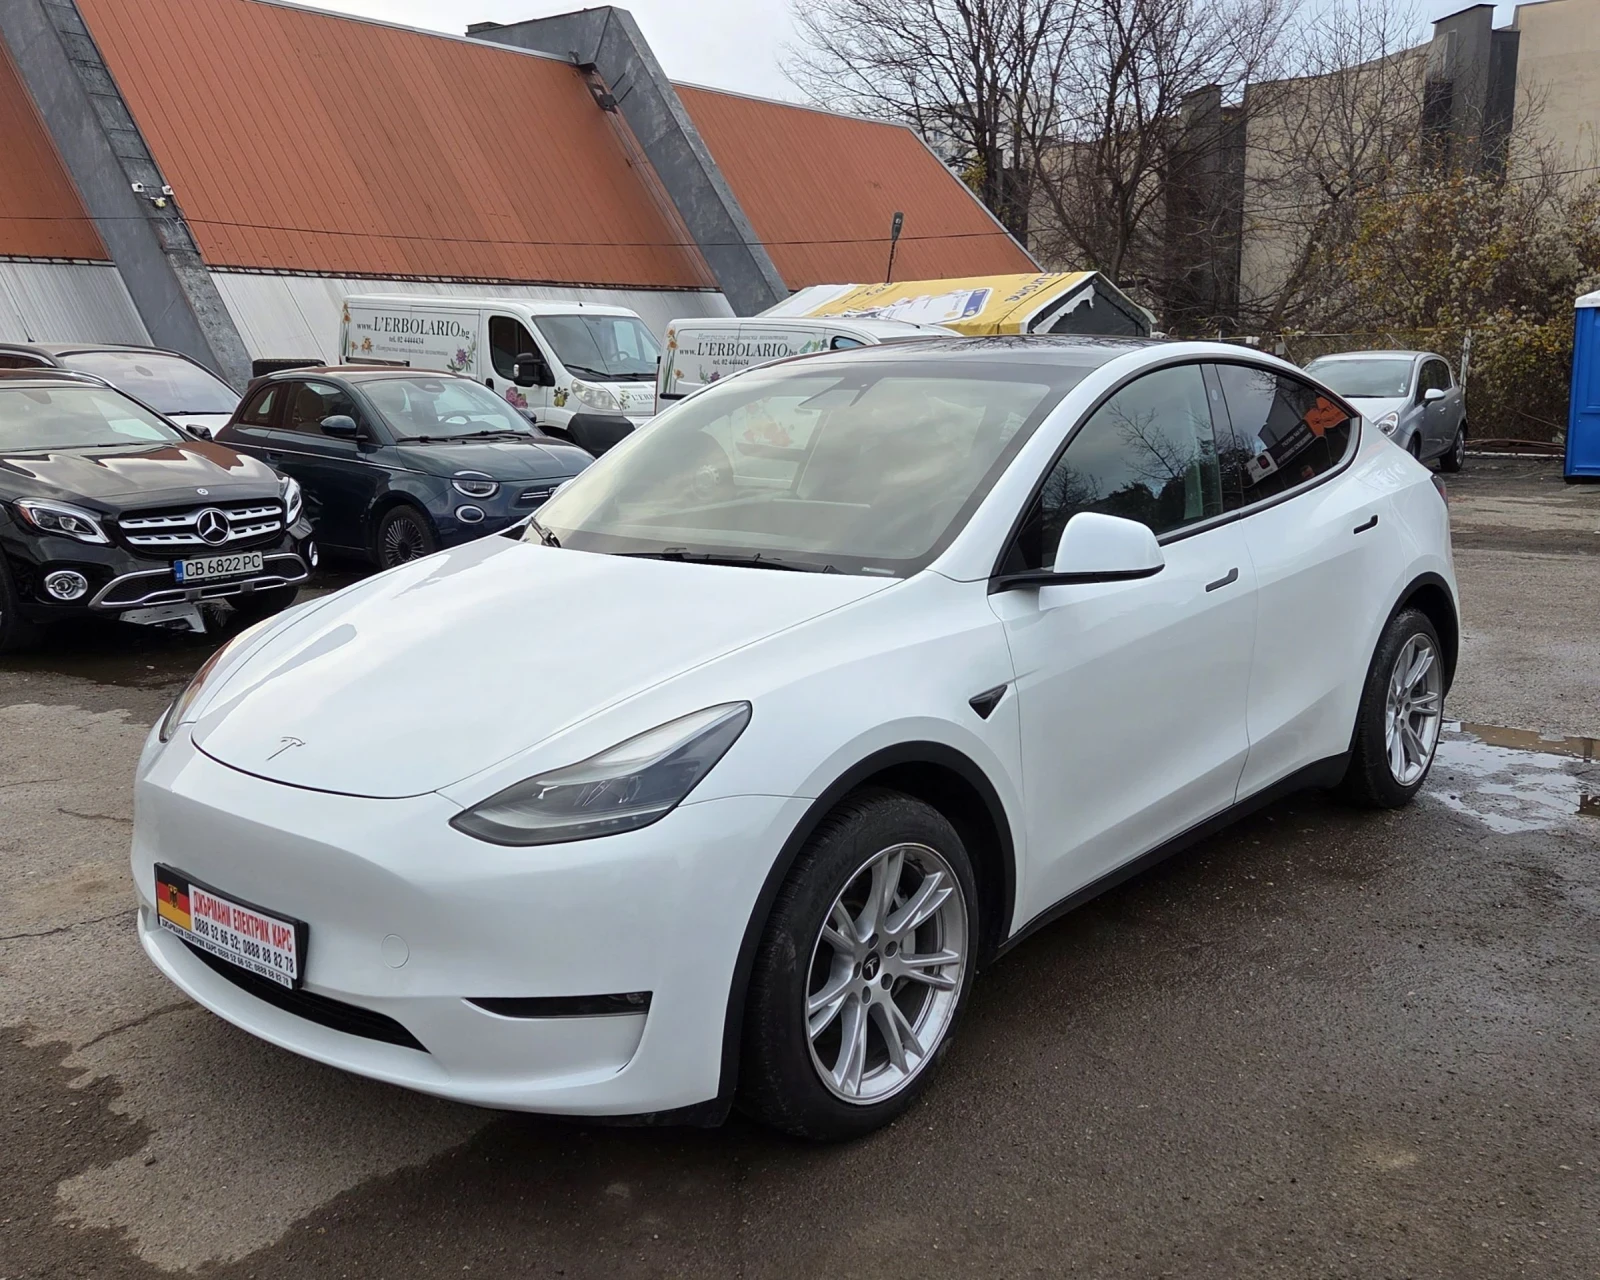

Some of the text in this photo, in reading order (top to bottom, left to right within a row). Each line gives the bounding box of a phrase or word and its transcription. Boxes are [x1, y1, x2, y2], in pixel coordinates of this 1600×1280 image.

[186, 555, 261, 577] CB 6822 PC
[194, 890, 292, 953] ДЖЪРМАНИ ЕЛЕКТРИК КАРС
[194, 917, 294, 973] 0888 52 66 52; 0888 88 82 78
